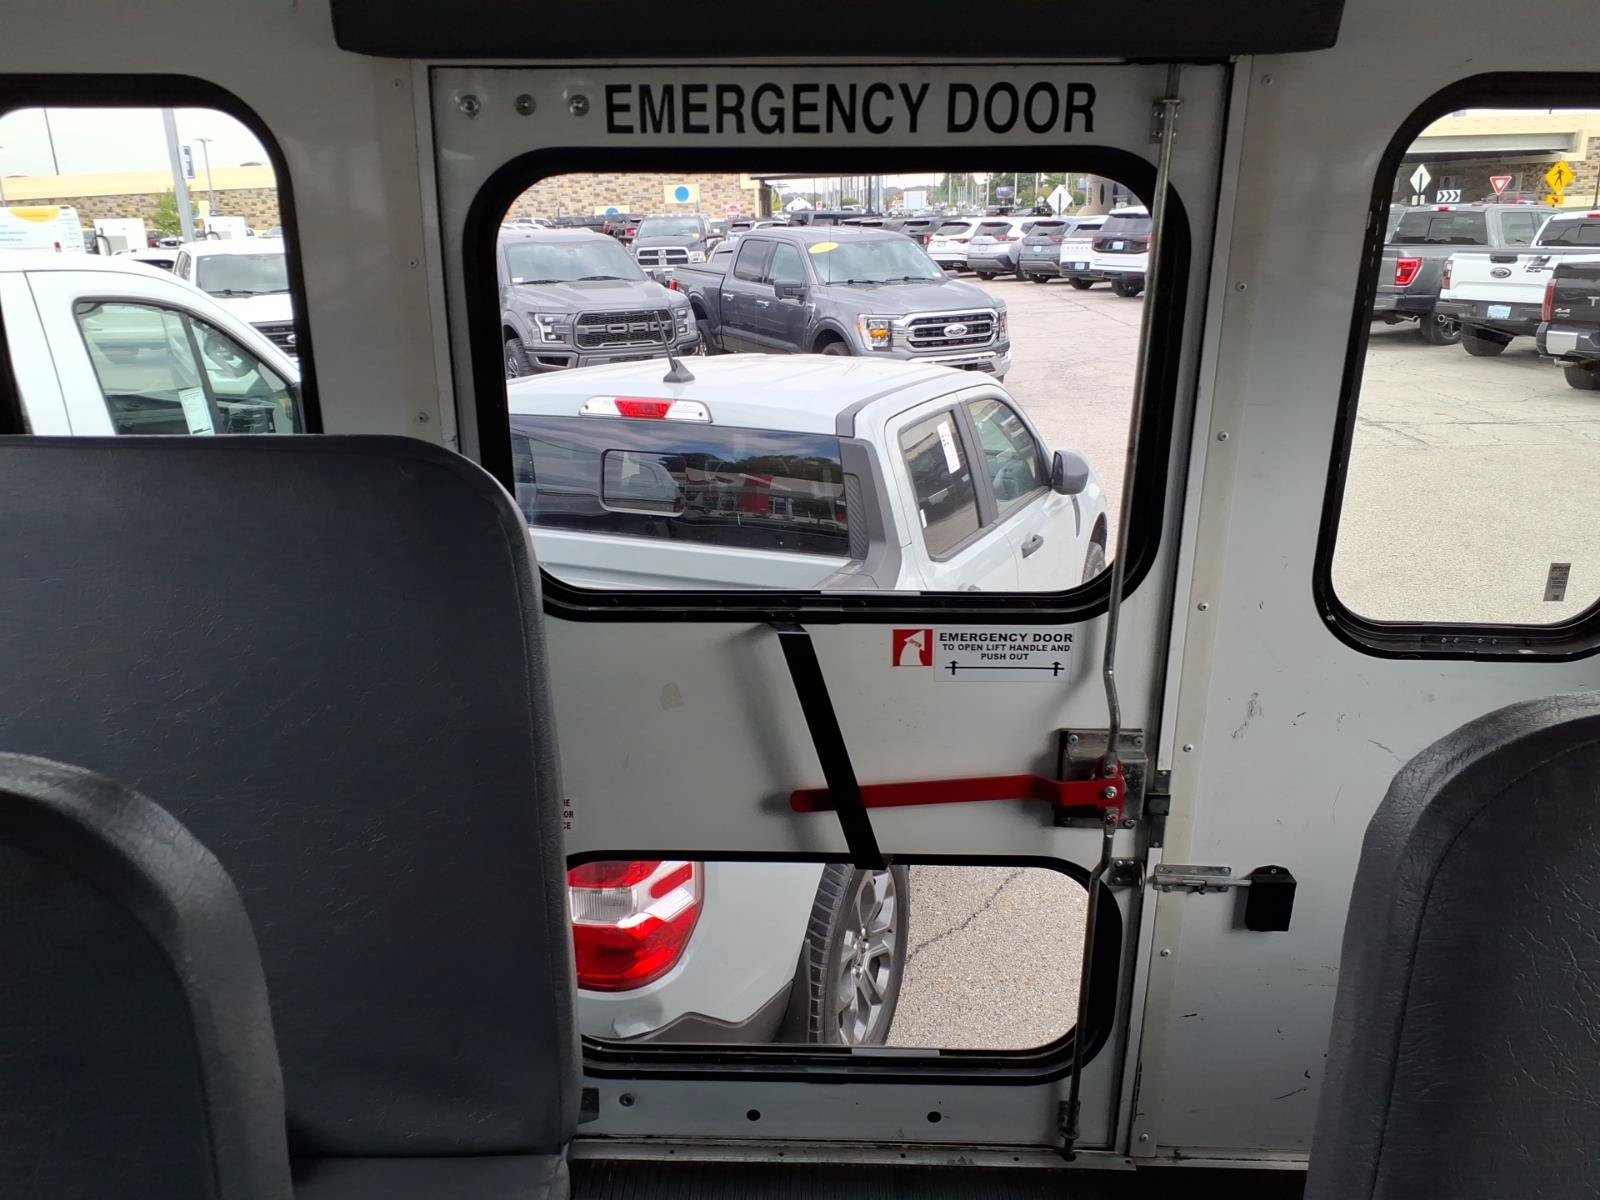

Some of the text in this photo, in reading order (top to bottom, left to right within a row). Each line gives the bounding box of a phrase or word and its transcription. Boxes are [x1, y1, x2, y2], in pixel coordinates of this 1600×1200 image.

[605, 81, 1097, 134] EMERGENCY DOOR
[939, 632, 1073, 643] EMERGENCY DOOR
[943, 643, 1071, 652] TO OPEN LIFT HANDLE AND
[980, 653, 1030, 661] PUSH OUT
